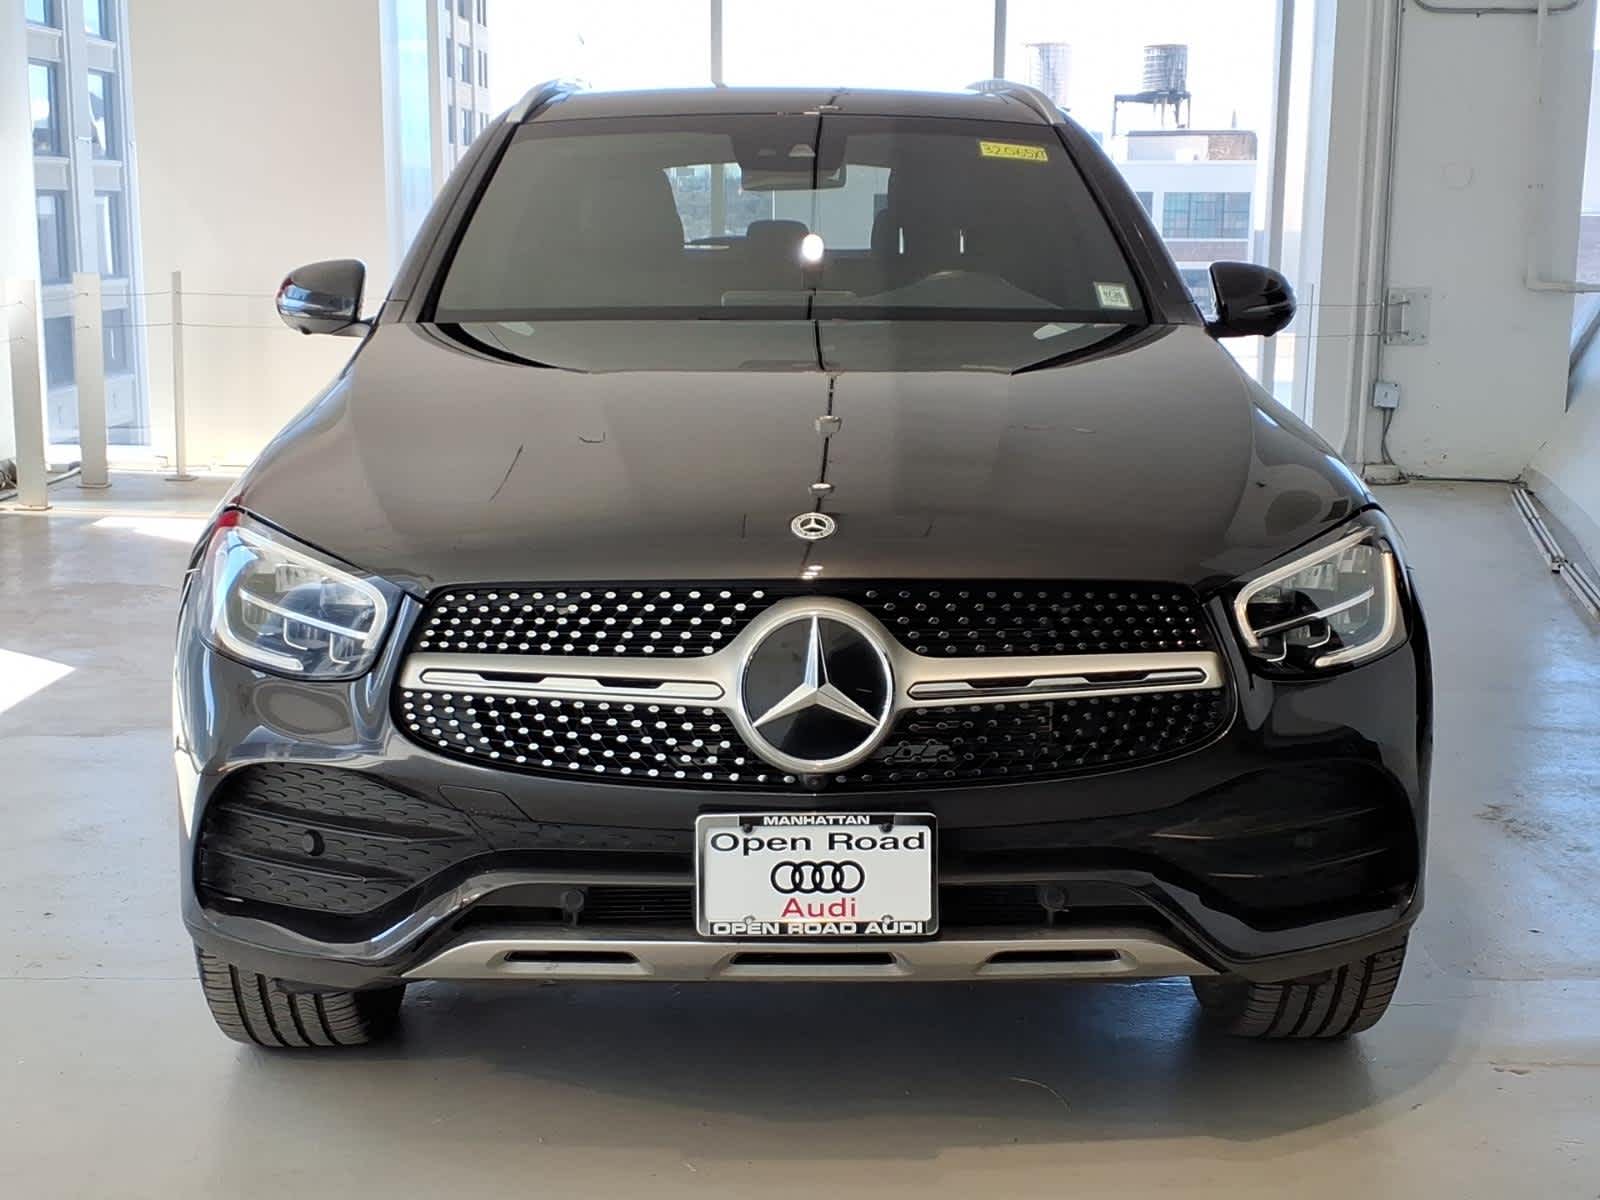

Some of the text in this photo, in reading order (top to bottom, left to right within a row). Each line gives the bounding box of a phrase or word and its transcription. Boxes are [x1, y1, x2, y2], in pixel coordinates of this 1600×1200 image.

[763, 815, 870, 826] MANHATTAN
[710, 831, 925, 856] Open Road
[781, 897, 856, 917] Audi
[712, 921, 923, 935] OPEN ROAD AUDI
